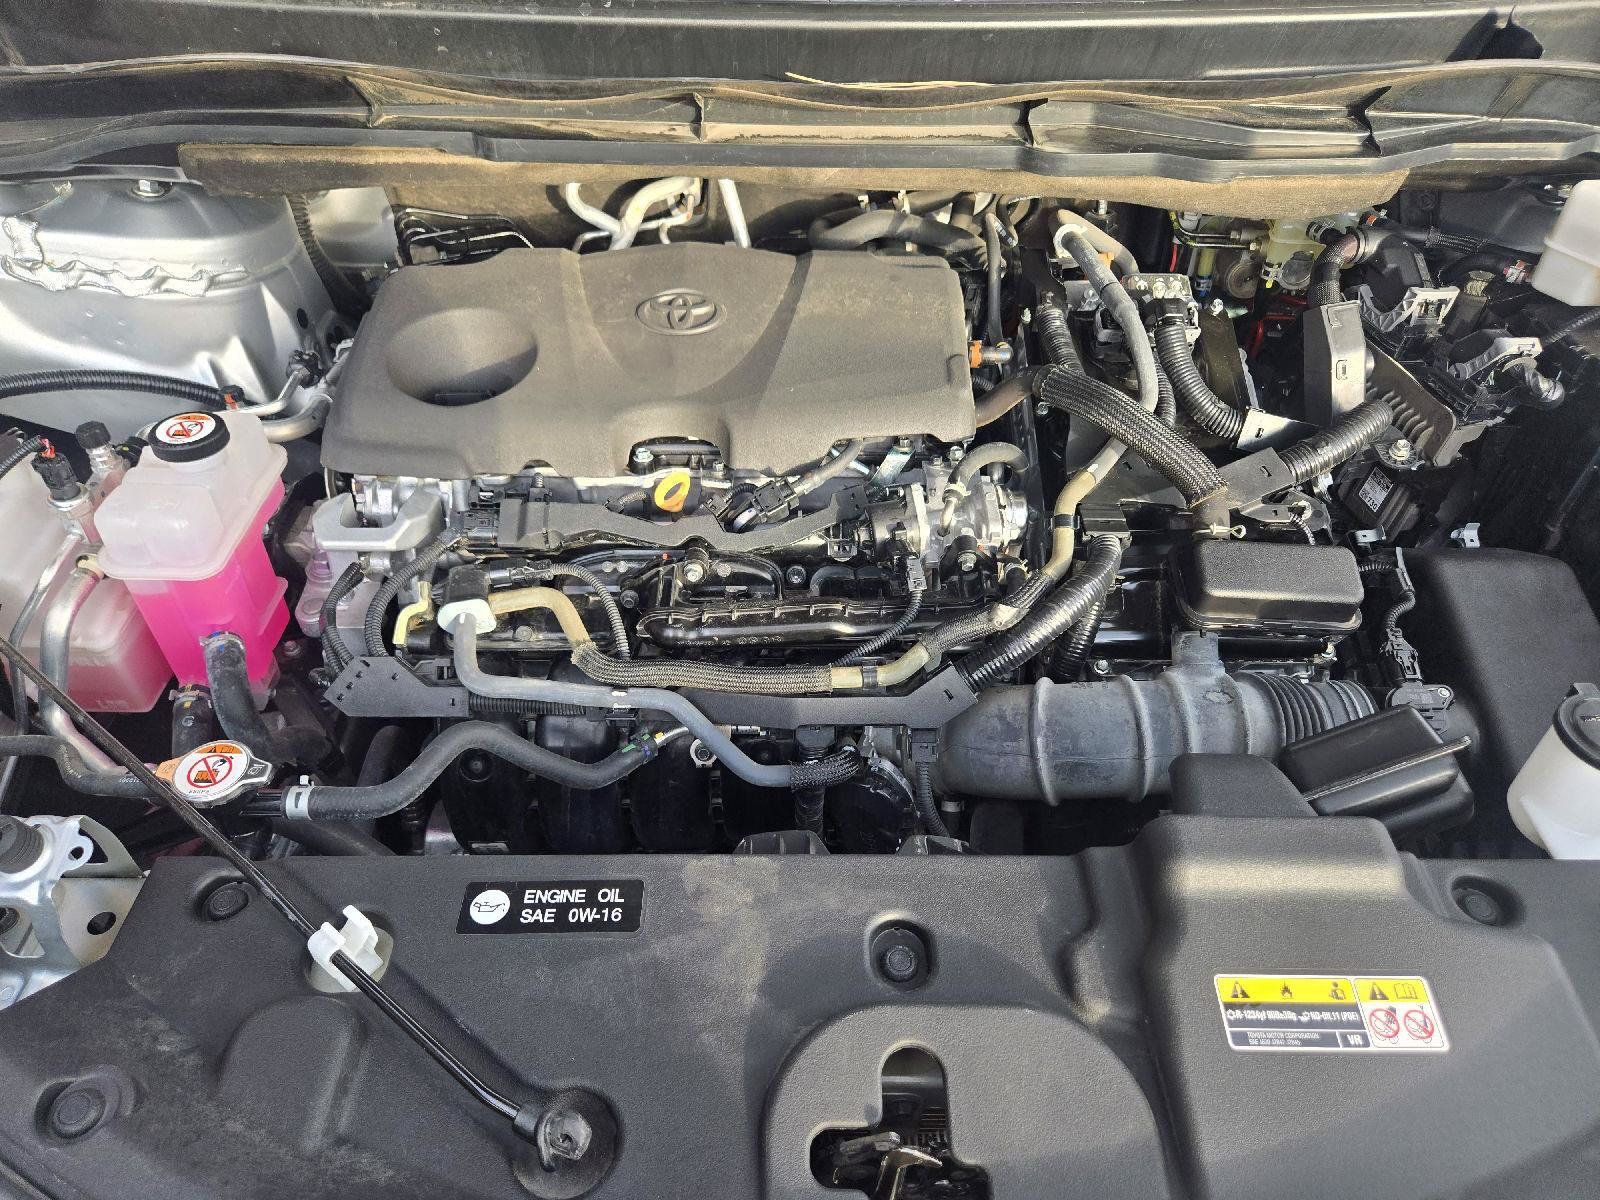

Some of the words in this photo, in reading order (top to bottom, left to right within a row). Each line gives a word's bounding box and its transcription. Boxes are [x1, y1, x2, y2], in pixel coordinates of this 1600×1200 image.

[523, 889, 586, 904] ENGINE
[597, 888, 625, 903] OIL
[520, 909, 556, 923] SAE
[568, 908, 622, 923] 0W-16
